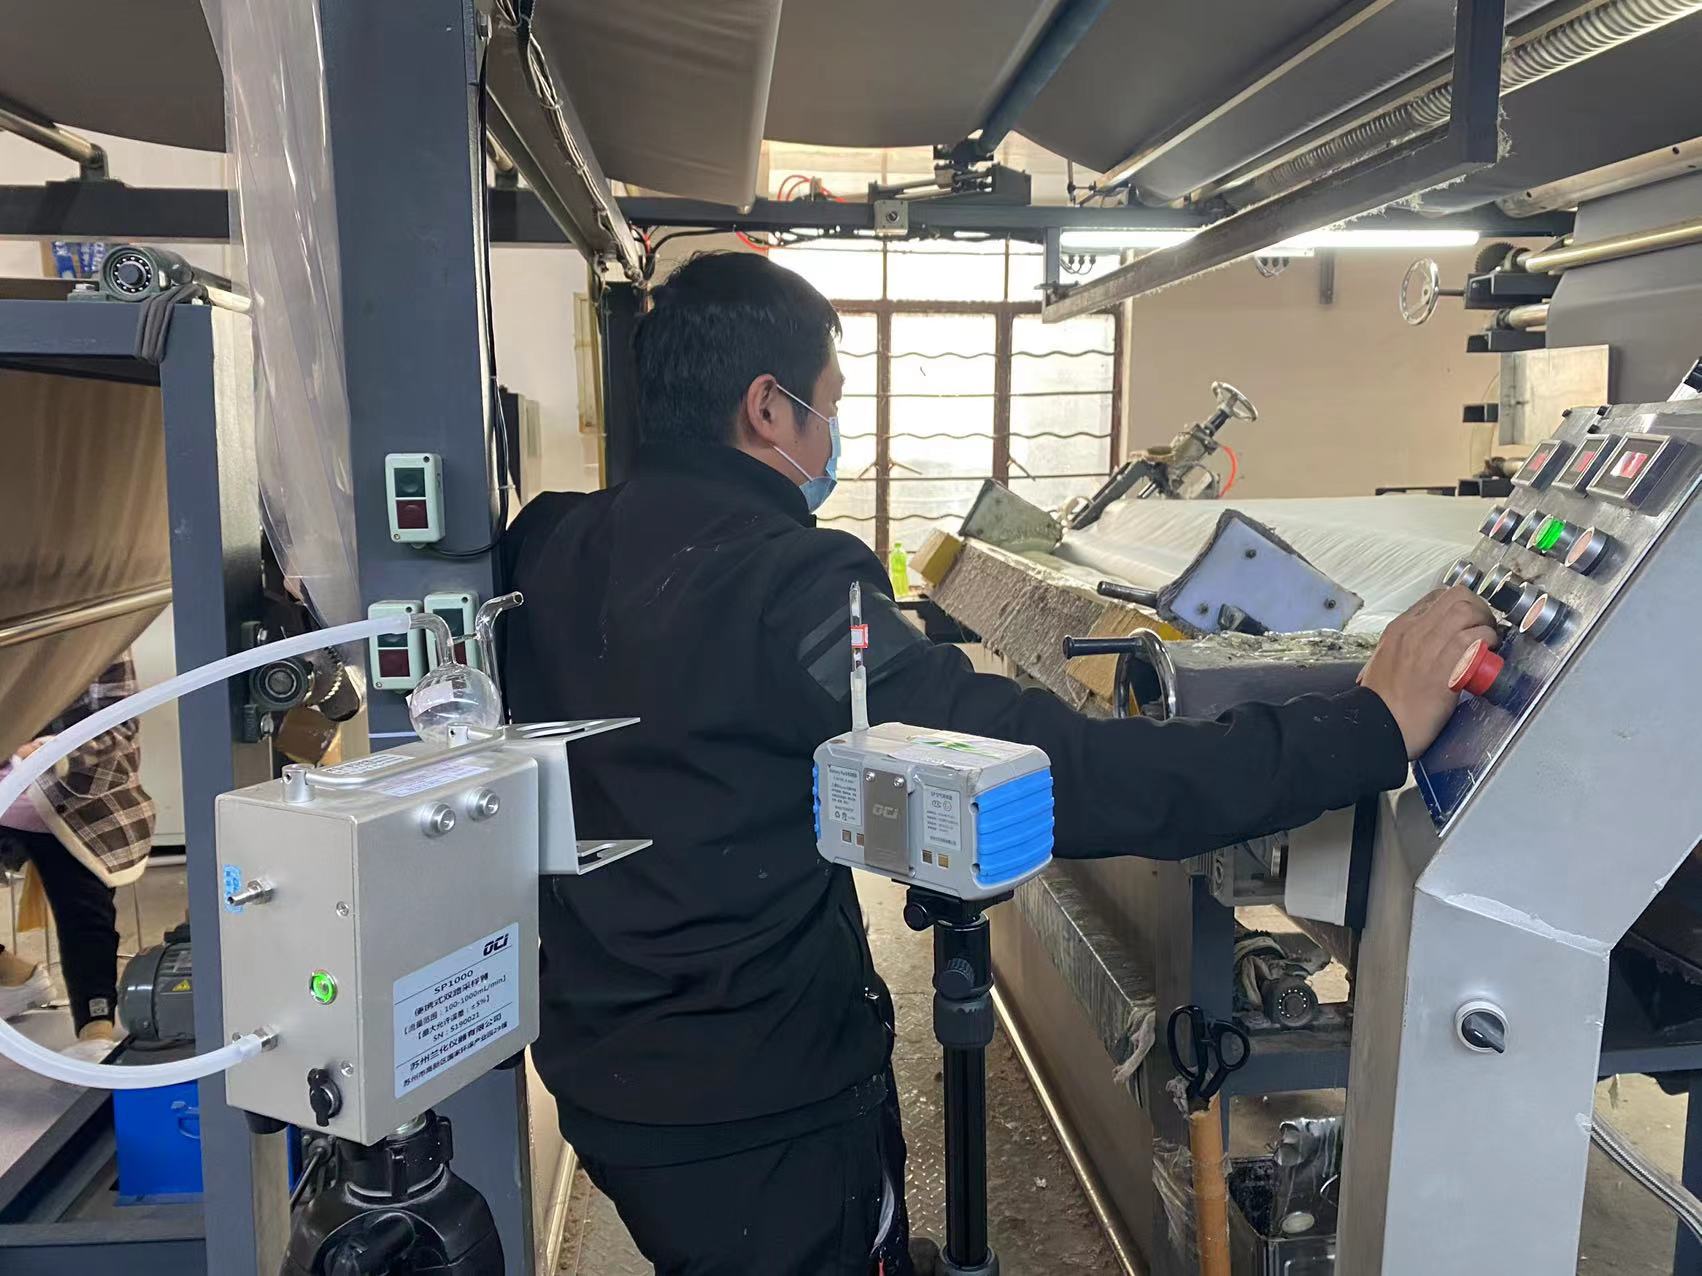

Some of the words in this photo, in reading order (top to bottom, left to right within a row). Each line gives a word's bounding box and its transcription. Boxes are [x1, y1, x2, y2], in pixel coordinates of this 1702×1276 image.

[434, 969, 474, 994] SP1000
[409, 1012, 502, 1072] 苏州兰化仪器有限公司
